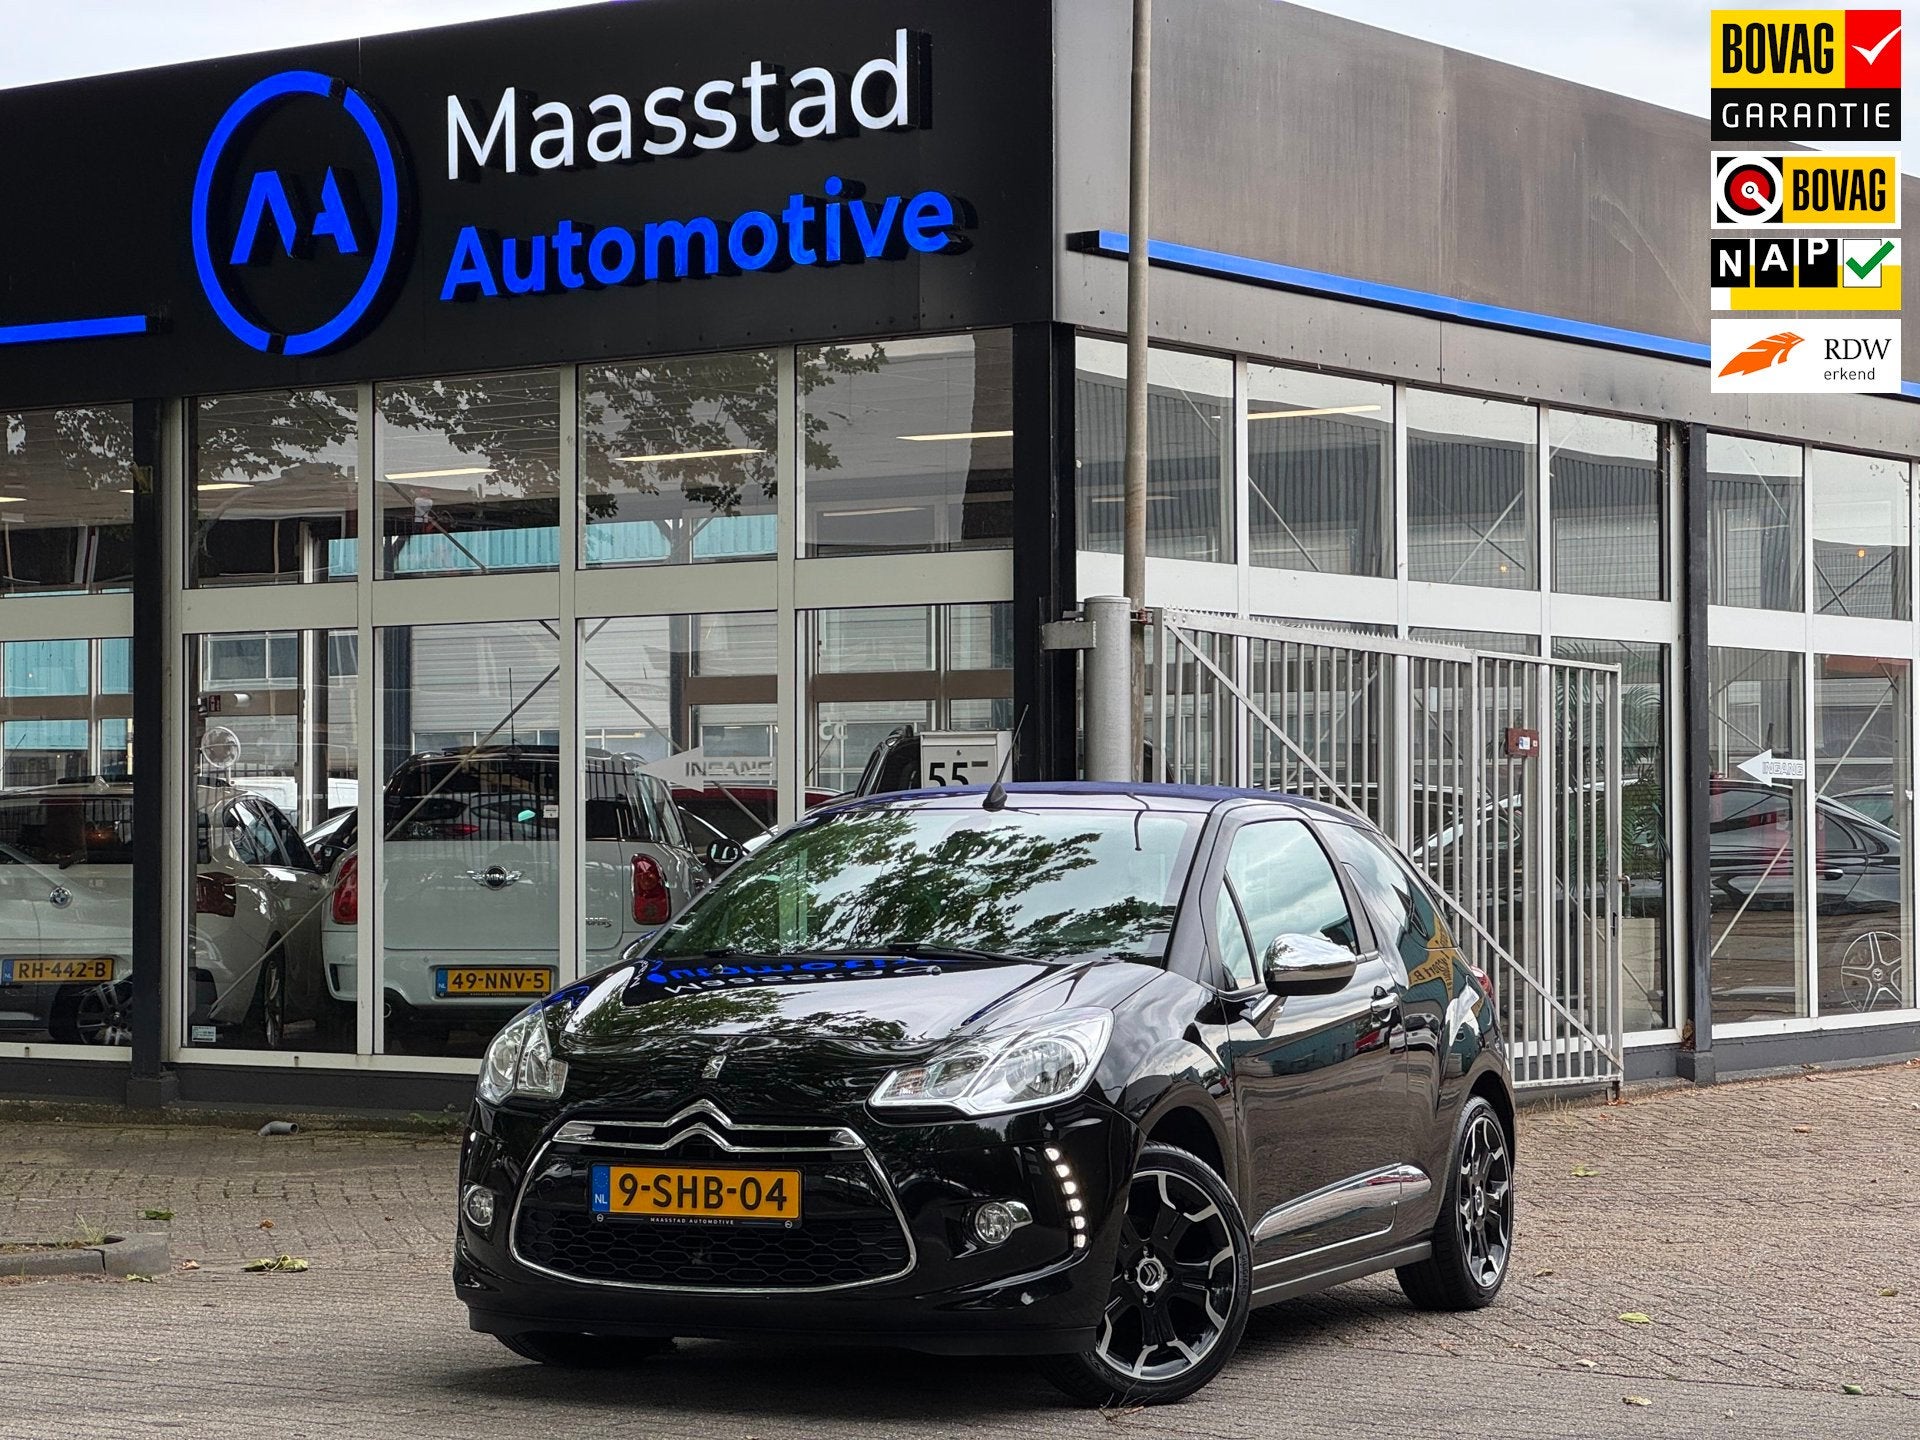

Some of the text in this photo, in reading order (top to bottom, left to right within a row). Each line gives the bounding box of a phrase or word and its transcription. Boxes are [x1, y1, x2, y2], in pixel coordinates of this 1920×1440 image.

[447, 28, 909, 180] Maasstad
[439, 176, 955, 301] Automotive
[1762, 761, 1803, 776] INGANG
[18, 962, 106, 978] RH-442-B
[452, 973, 544, 989] 49-NNV-5
[594, 1173, 787, 1211] NL 9-SHB-04
